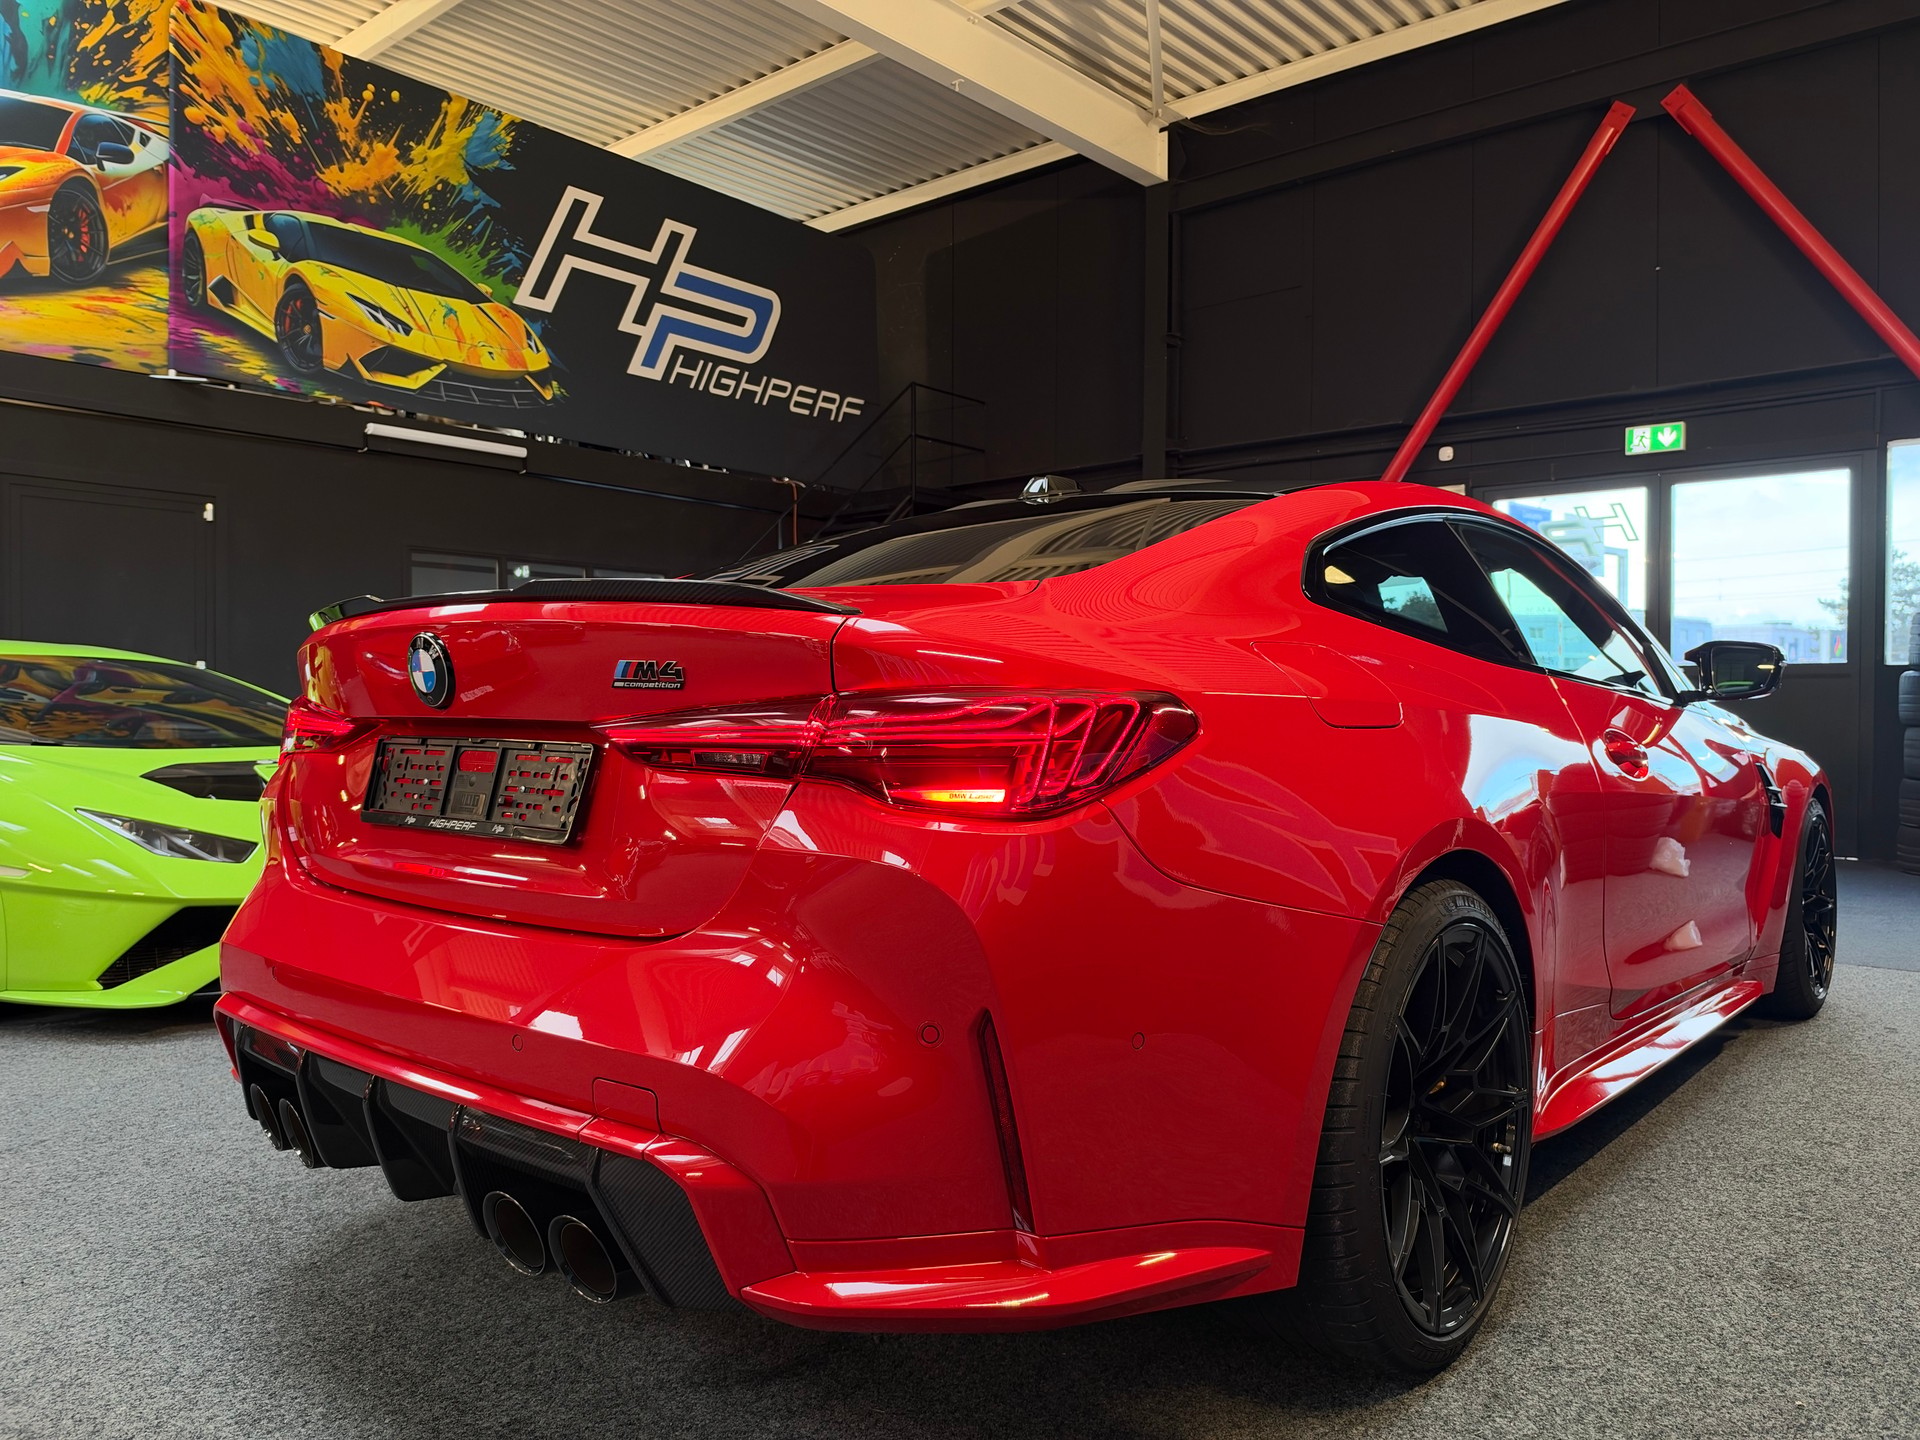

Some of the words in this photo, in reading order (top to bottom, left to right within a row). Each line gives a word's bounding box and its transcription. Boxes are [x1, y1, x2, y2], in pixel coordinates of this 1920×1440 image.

[513, 185, 782, 381] HP
[669, 354, 865, 423] HIGHPERF
[632, 659, 684, 681] M4
[624, 681, 681, 689] competition
[428, 818, 478, 830] HIGHPERF
